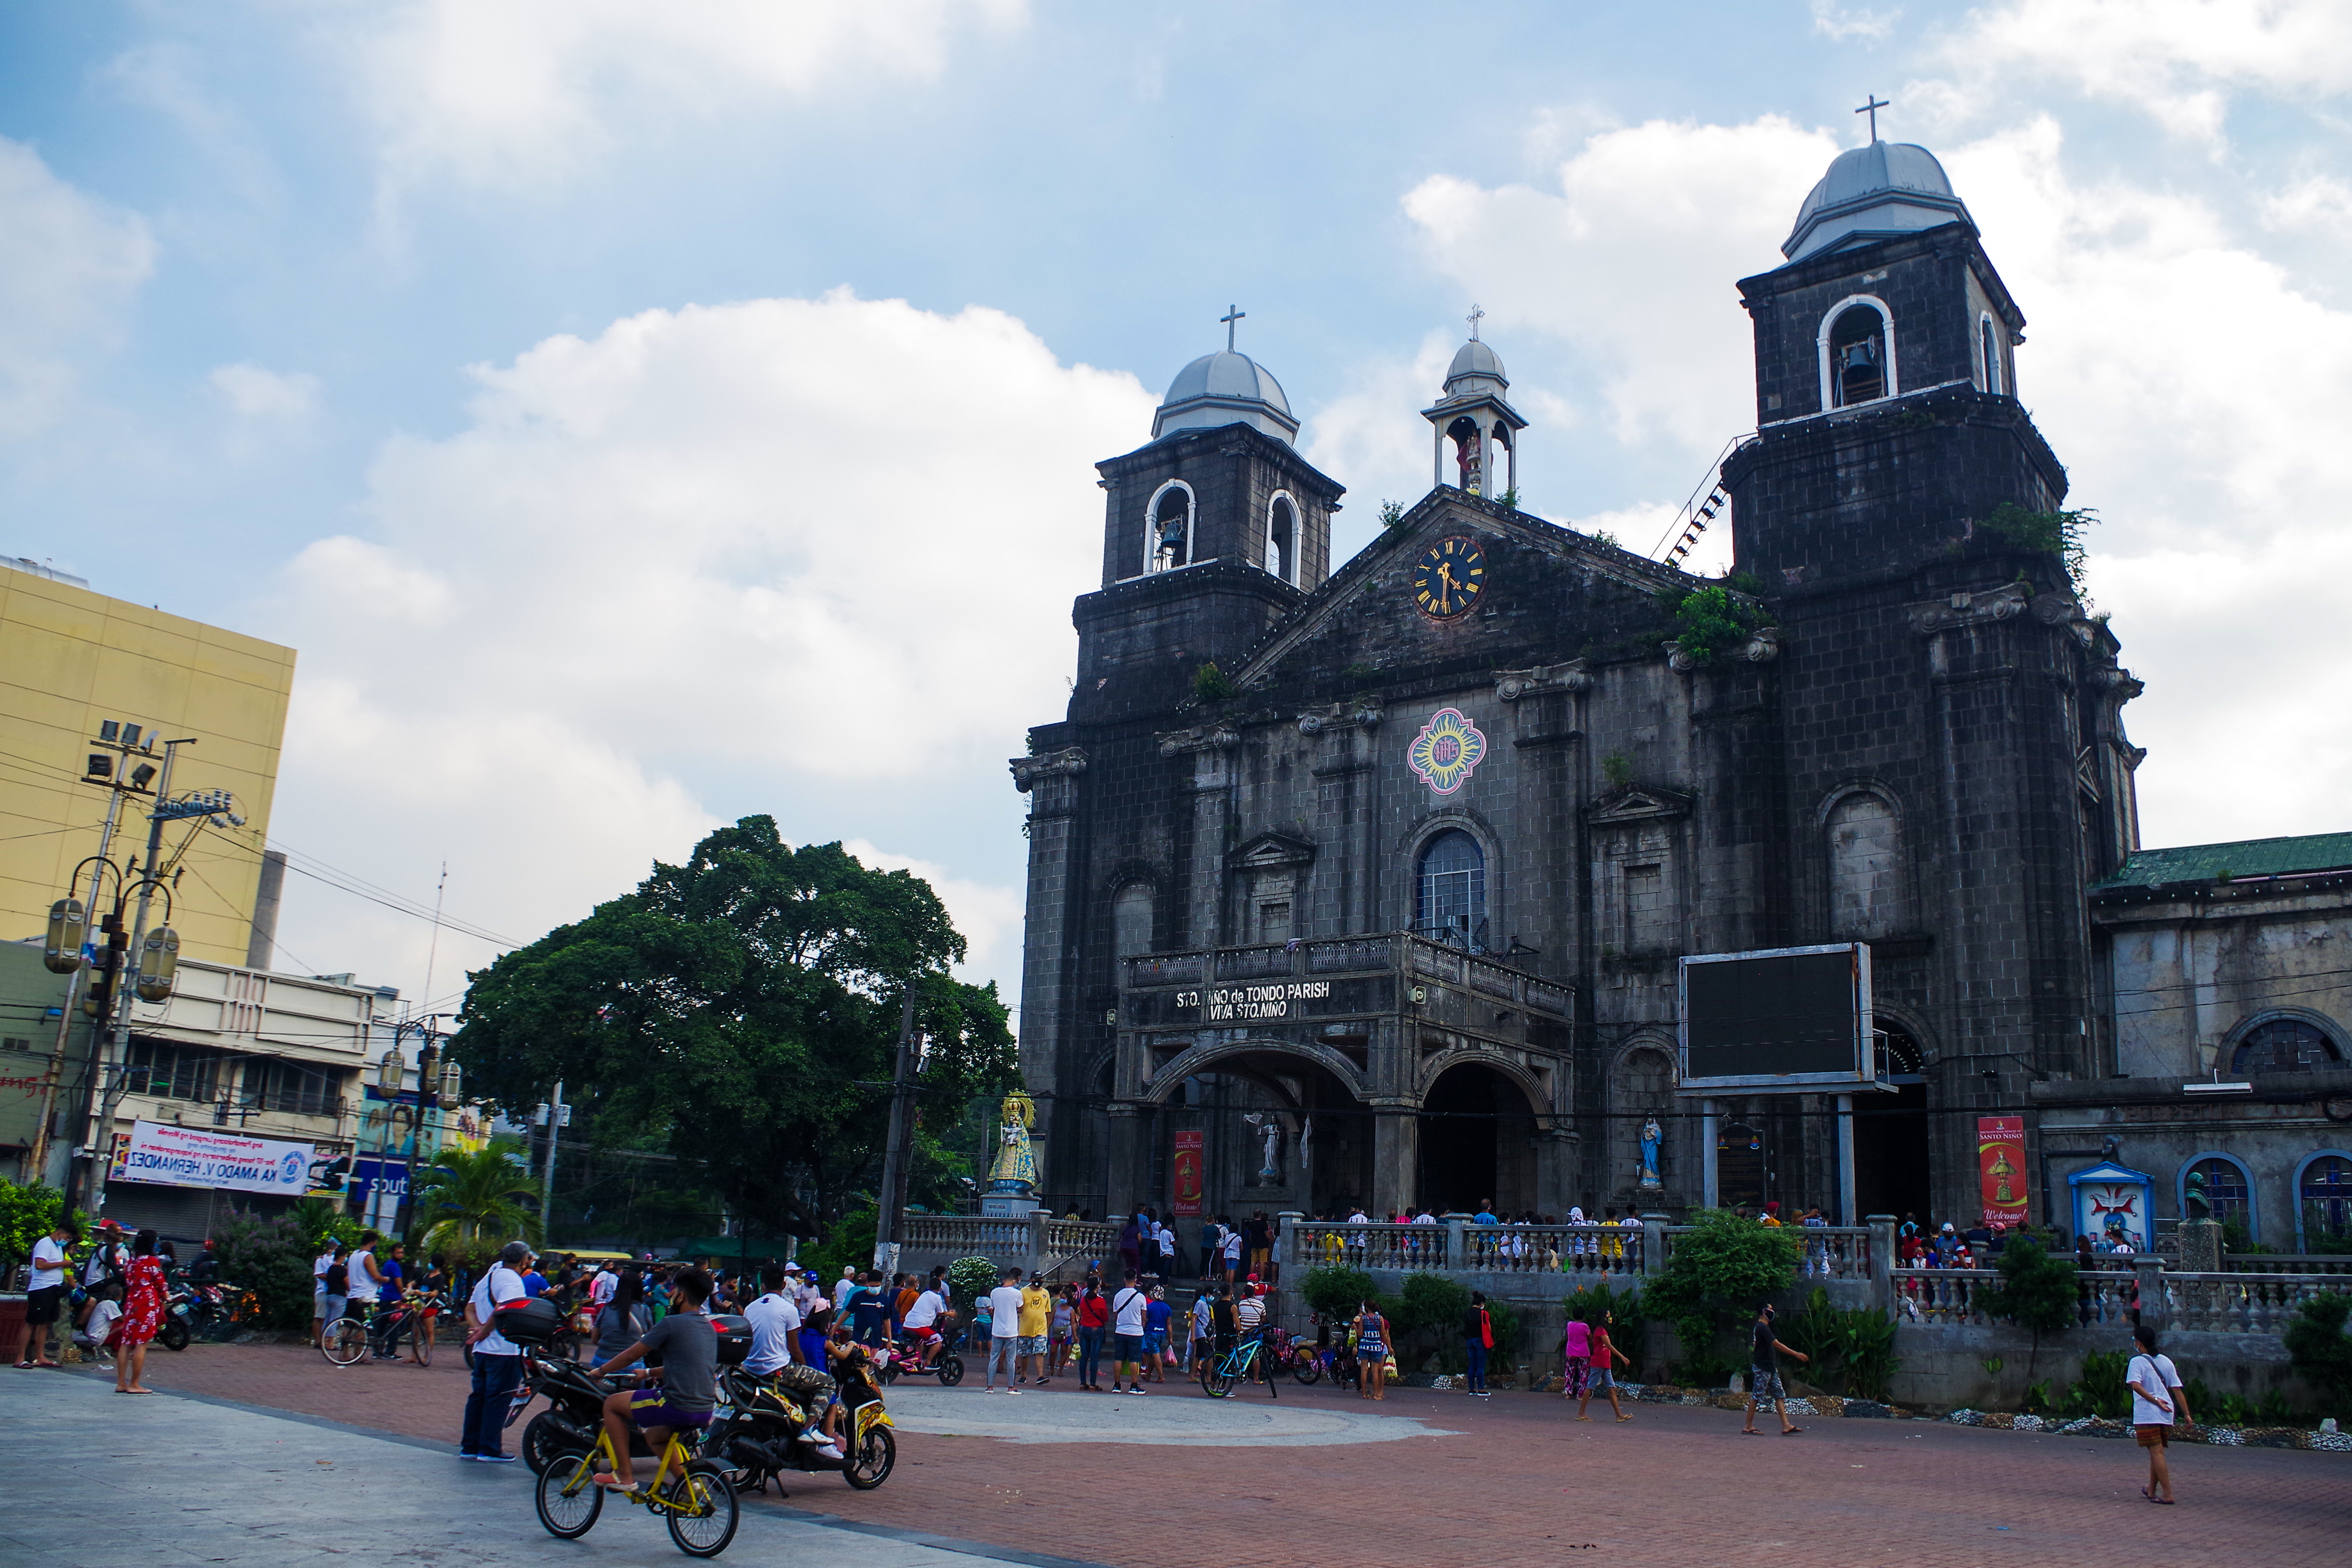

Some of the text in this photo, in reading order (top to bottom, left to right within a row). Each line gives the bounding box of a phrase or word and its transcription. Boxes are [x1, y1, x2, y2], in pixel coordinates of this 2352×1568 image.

[1419, 563, 1431, 572] X
[1177, 991, 1200, 1008] STO.
[1231, 988, 1244, 1003] de
[1246, 985, 1285, 1002] TONDO
[1288, 982, 1329, 999] PARISH
[1210, 1004, 1233, 1020] VIVA
[370, 1177, 409, 1194] sout
[1983, 1209, 2027, 1220] Welcome!
